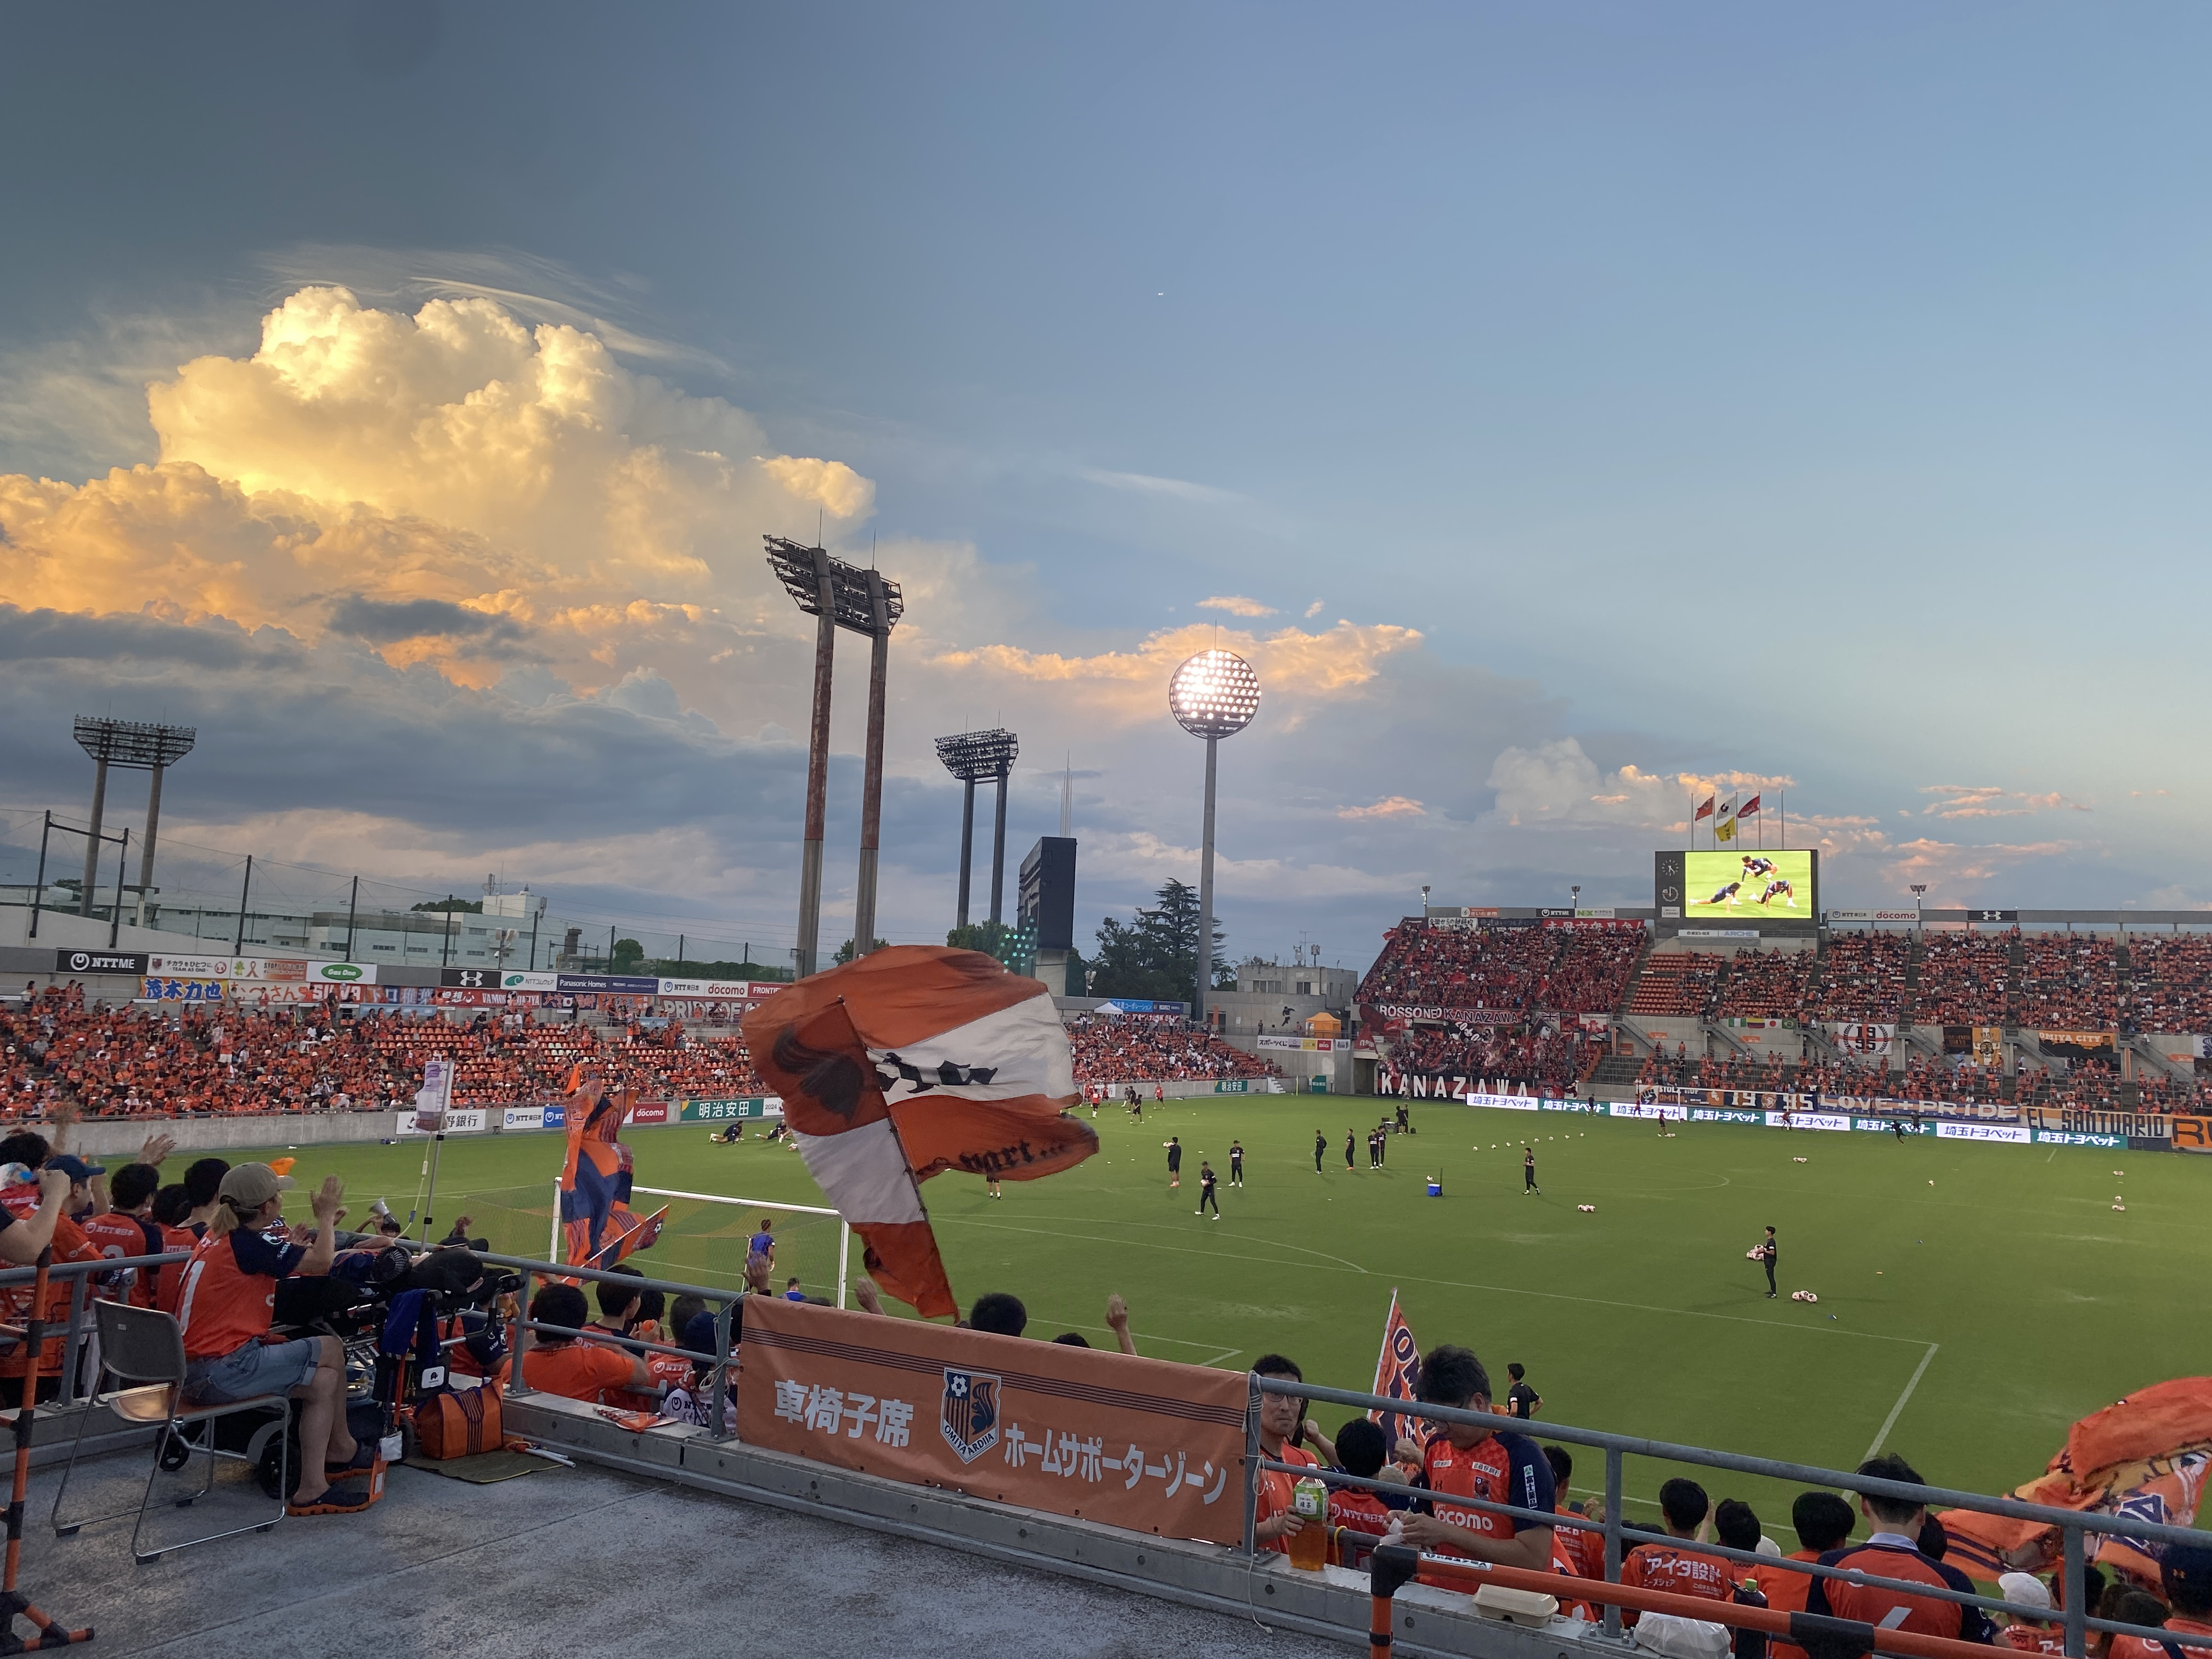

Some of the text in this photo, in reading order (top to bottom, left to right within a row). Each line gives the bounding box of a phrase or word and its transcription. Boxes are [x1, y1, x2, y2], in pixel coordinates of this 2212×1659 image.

[144, 978, 223, 1001] 茂木力也
[559, 979, 587, 988] Panasonic
[708, 983, 744, 995] docomo
[482, 993, 506, 1005] VAMOS
[1443, 1008, 1519, 1024] KANAZAWA
[1856, 1026, 1876, 1038] 19
[2039, 1032, 2073, 1042] OMIYA
[1259, 1039, 1288, 1047] スポーツくじ
[1855, 1039, 1876, 1051] 95
[1221, 1081, 1242, 1092] 明治安田
[1381, 1072, 1528, 1099] KANAZAWA
[1472, 1095, 1532, 1108] 埼玉トヨペット
[636, 1108, 664, 1117] docomo
[698, 1101, 750, 1119] 明治安田
[1692, 1109, 1760, 1123] 埼玉トヨペット
[2026, 1108, 2164, 1137] EL SANTUARIO
[1944, 1125, 2023, 1139] 埼玉トヨペット
[2037, 1131, 2120, 1147] 埼玉トヨペット
[774, 1379, 914, 1448] 車椅子席
[945, 1425, 995, 1456] OMIYA ARDIJA
[1005, 1423, 1227, 1505] ホームサポーターゾーン
[1525, 1476, 1538, 1508] 富士薬品
[1342, 1508, 1386, 1523] NTT東日本
[1646, 1558, 1722, 1585] アイダ設計
